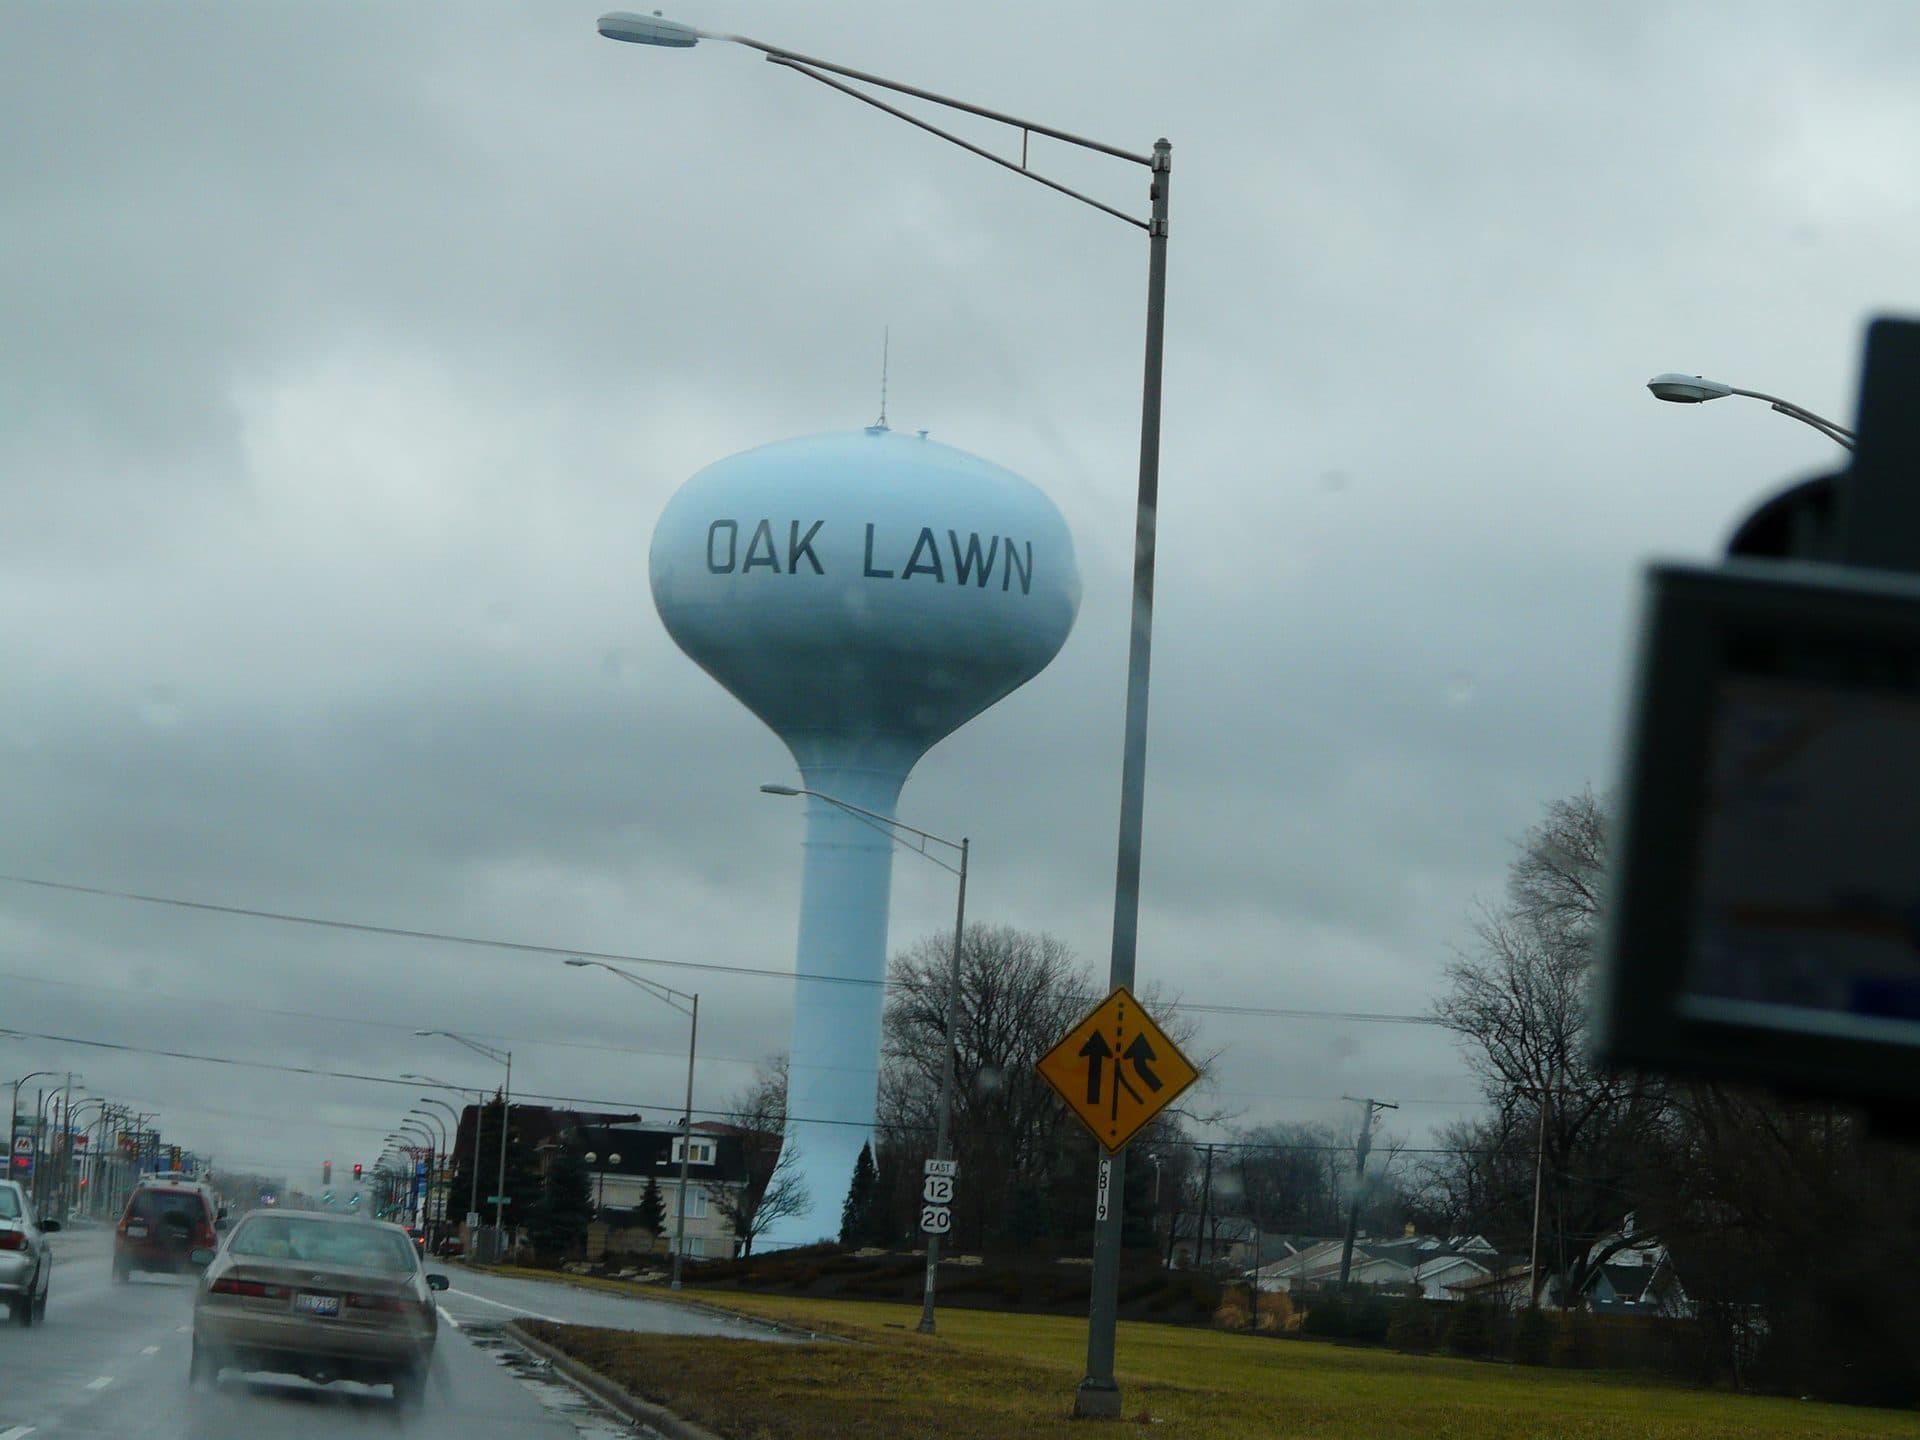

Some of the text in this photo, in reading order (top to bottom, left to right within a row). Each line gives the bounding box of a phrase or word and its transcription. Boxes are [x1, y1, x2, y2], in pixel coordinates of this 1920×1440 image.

[707, 518, 1033, 596] OAK LAWN
[929, 1161, 951, 1173] EAST
[929, 1181, 948, 1198] 12
[923, 1211, 949, 1228] 20
